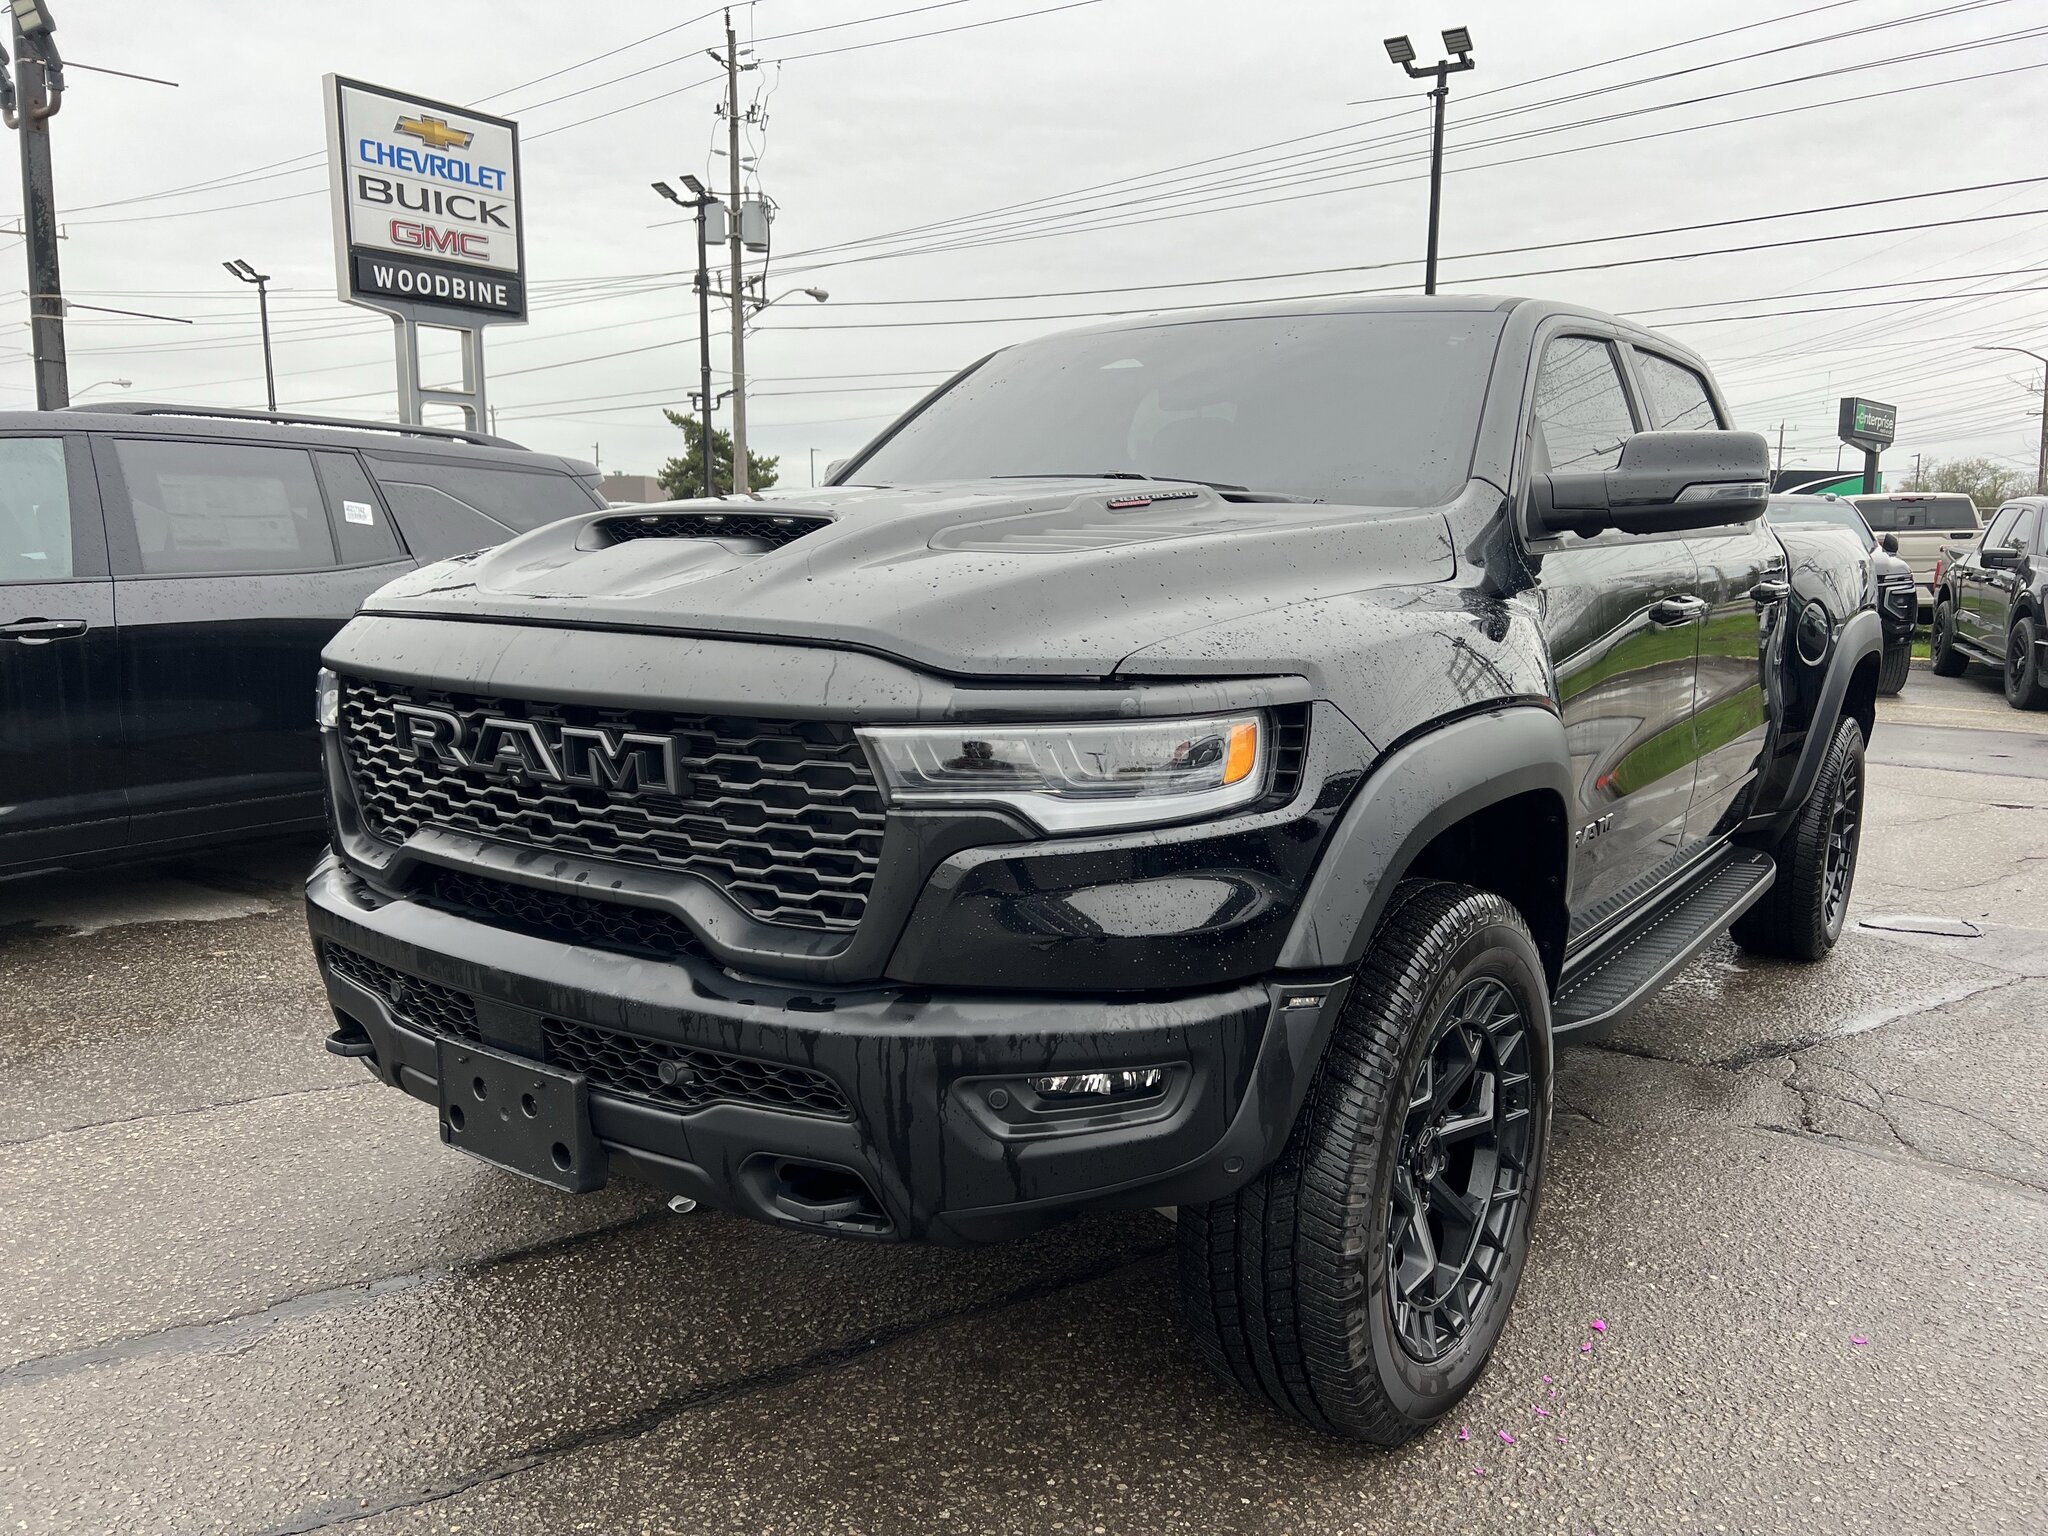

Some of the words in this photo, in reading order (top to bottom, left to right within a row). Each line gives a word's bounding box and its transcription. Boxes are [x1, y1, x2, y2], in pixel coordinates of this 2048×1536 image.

[360, 138, 506, 191] CHEVROLET
[358, 174, 510, 229] BUICK
[389, 219, 490, 261] GMC
[373, 264, 508, 306] WOODBINE
[1857, 412, 1894, 430] enterprise
[393, 703, 682, 796] RAM
